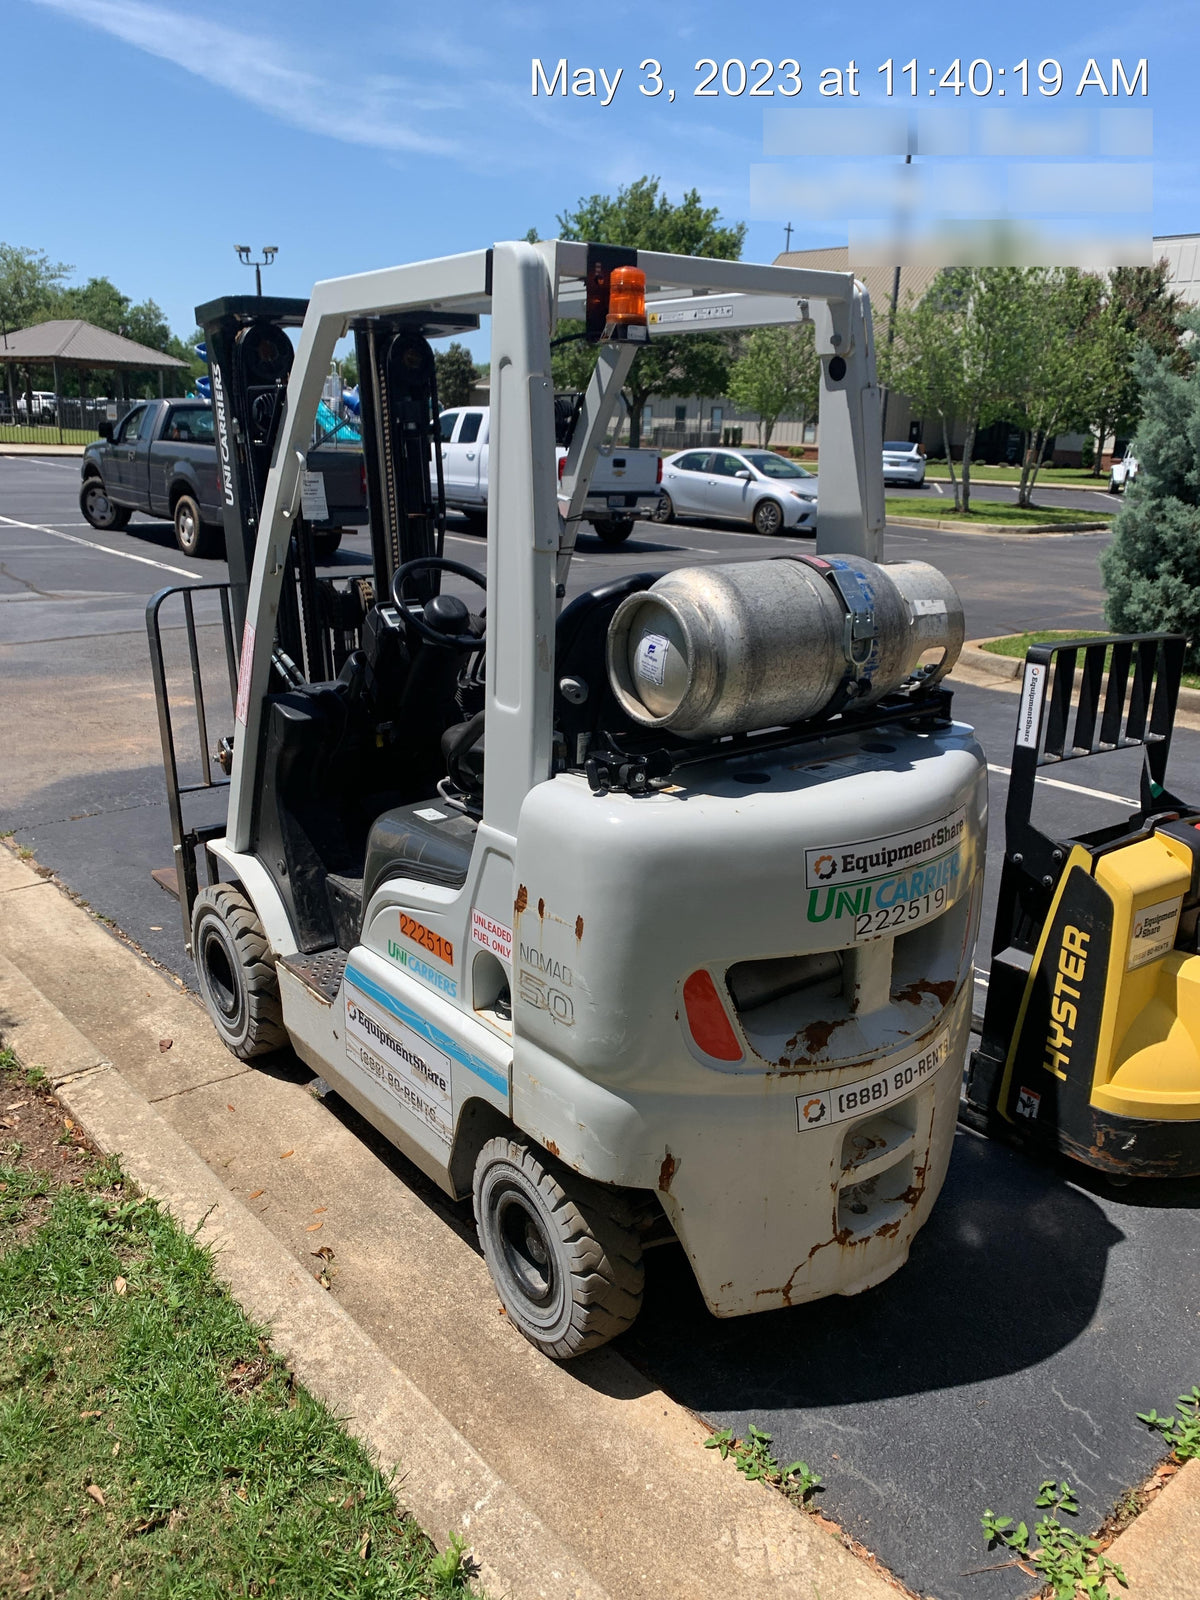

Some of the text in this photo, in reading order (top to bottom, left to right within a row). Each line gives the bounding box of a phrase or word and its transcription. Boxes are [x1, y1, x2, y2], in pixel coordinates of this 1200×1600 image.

[1024, 677, 1038, 742] EquipmentShare
[842, 819, 964, 874] EquipmentShare
[474, 913, 512, 943] UNLEADED
[856, 887, 945, 935] 222519
[400, 913, 453, 966] 222519
[474, 928, 511, 958] FUEL ONLY
[520, 942, 572, 987] NOMAD
[520, 969, 575, 1027] 50
[1042, 924, 1091, 1082] HYSTER
[357, 1008, 447, 1091] EquipmentShare
[838, 1039, 949, 1113] (888) 80-RENTS
